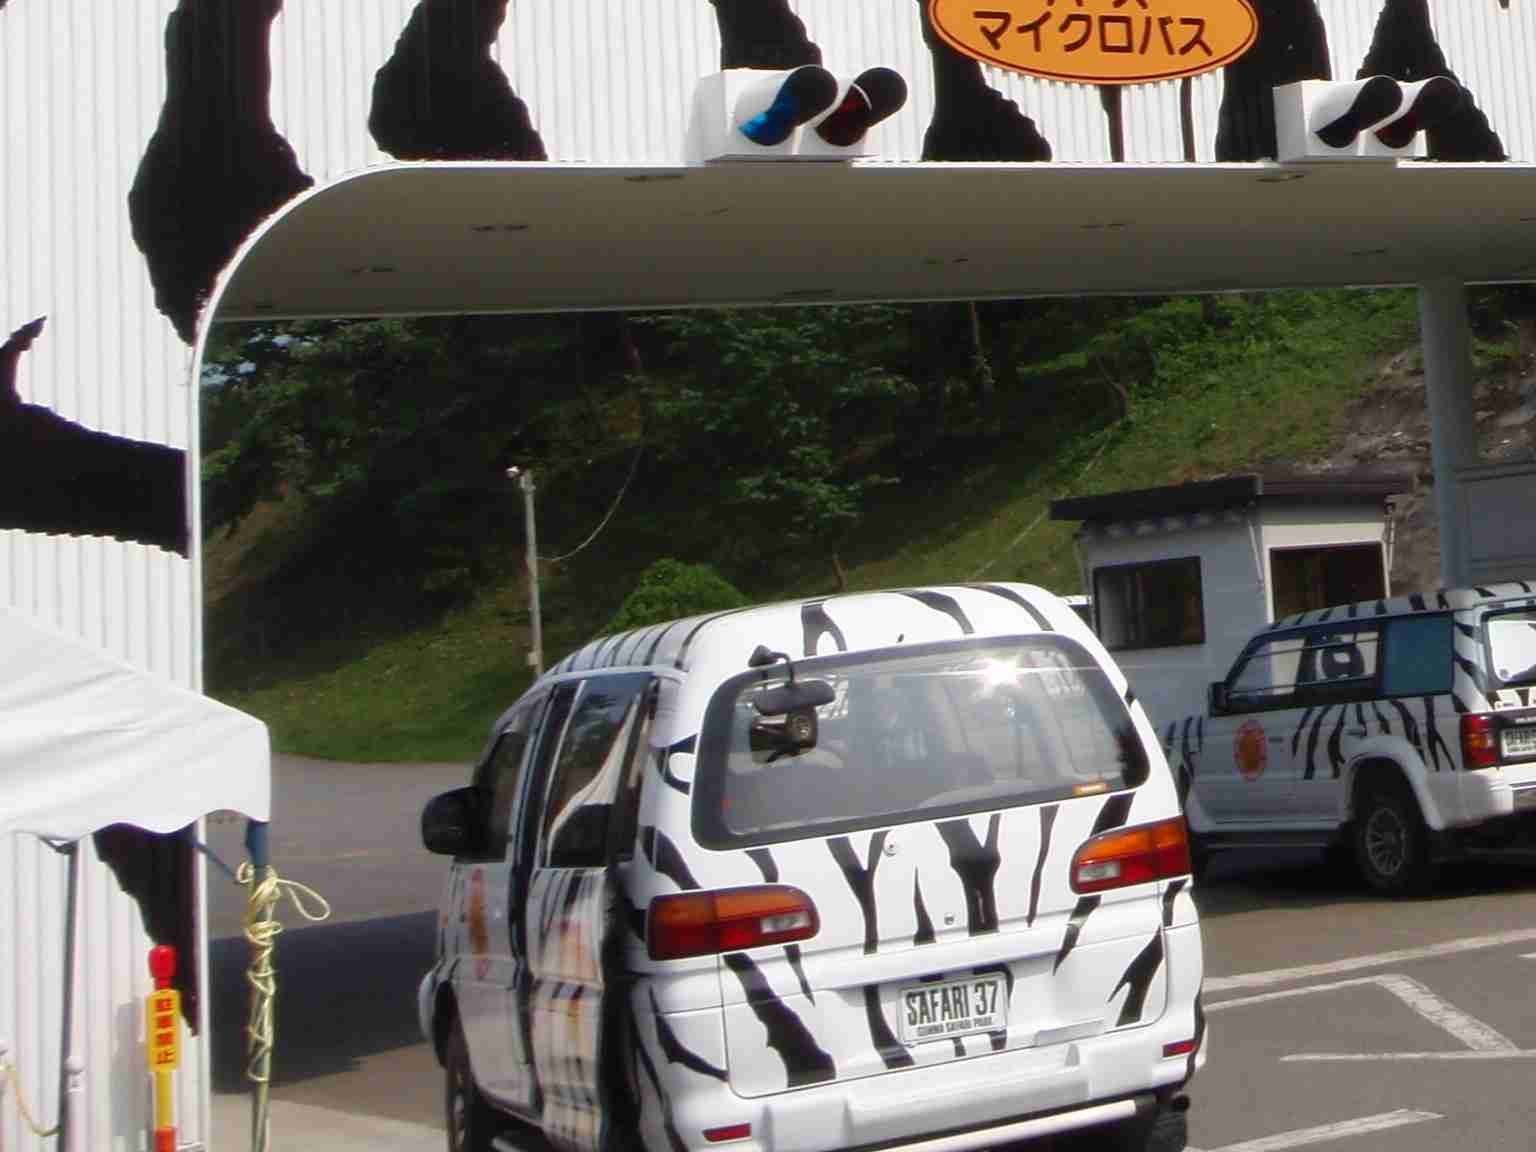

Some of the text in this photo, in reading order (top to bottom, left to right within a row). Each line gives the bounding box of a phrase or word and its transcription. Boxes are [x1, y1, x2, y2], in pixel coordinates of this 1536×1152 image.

[973, 10, 1213, 56] マイクロバス
[905, 980, 999, 1026] SAFARI 37
